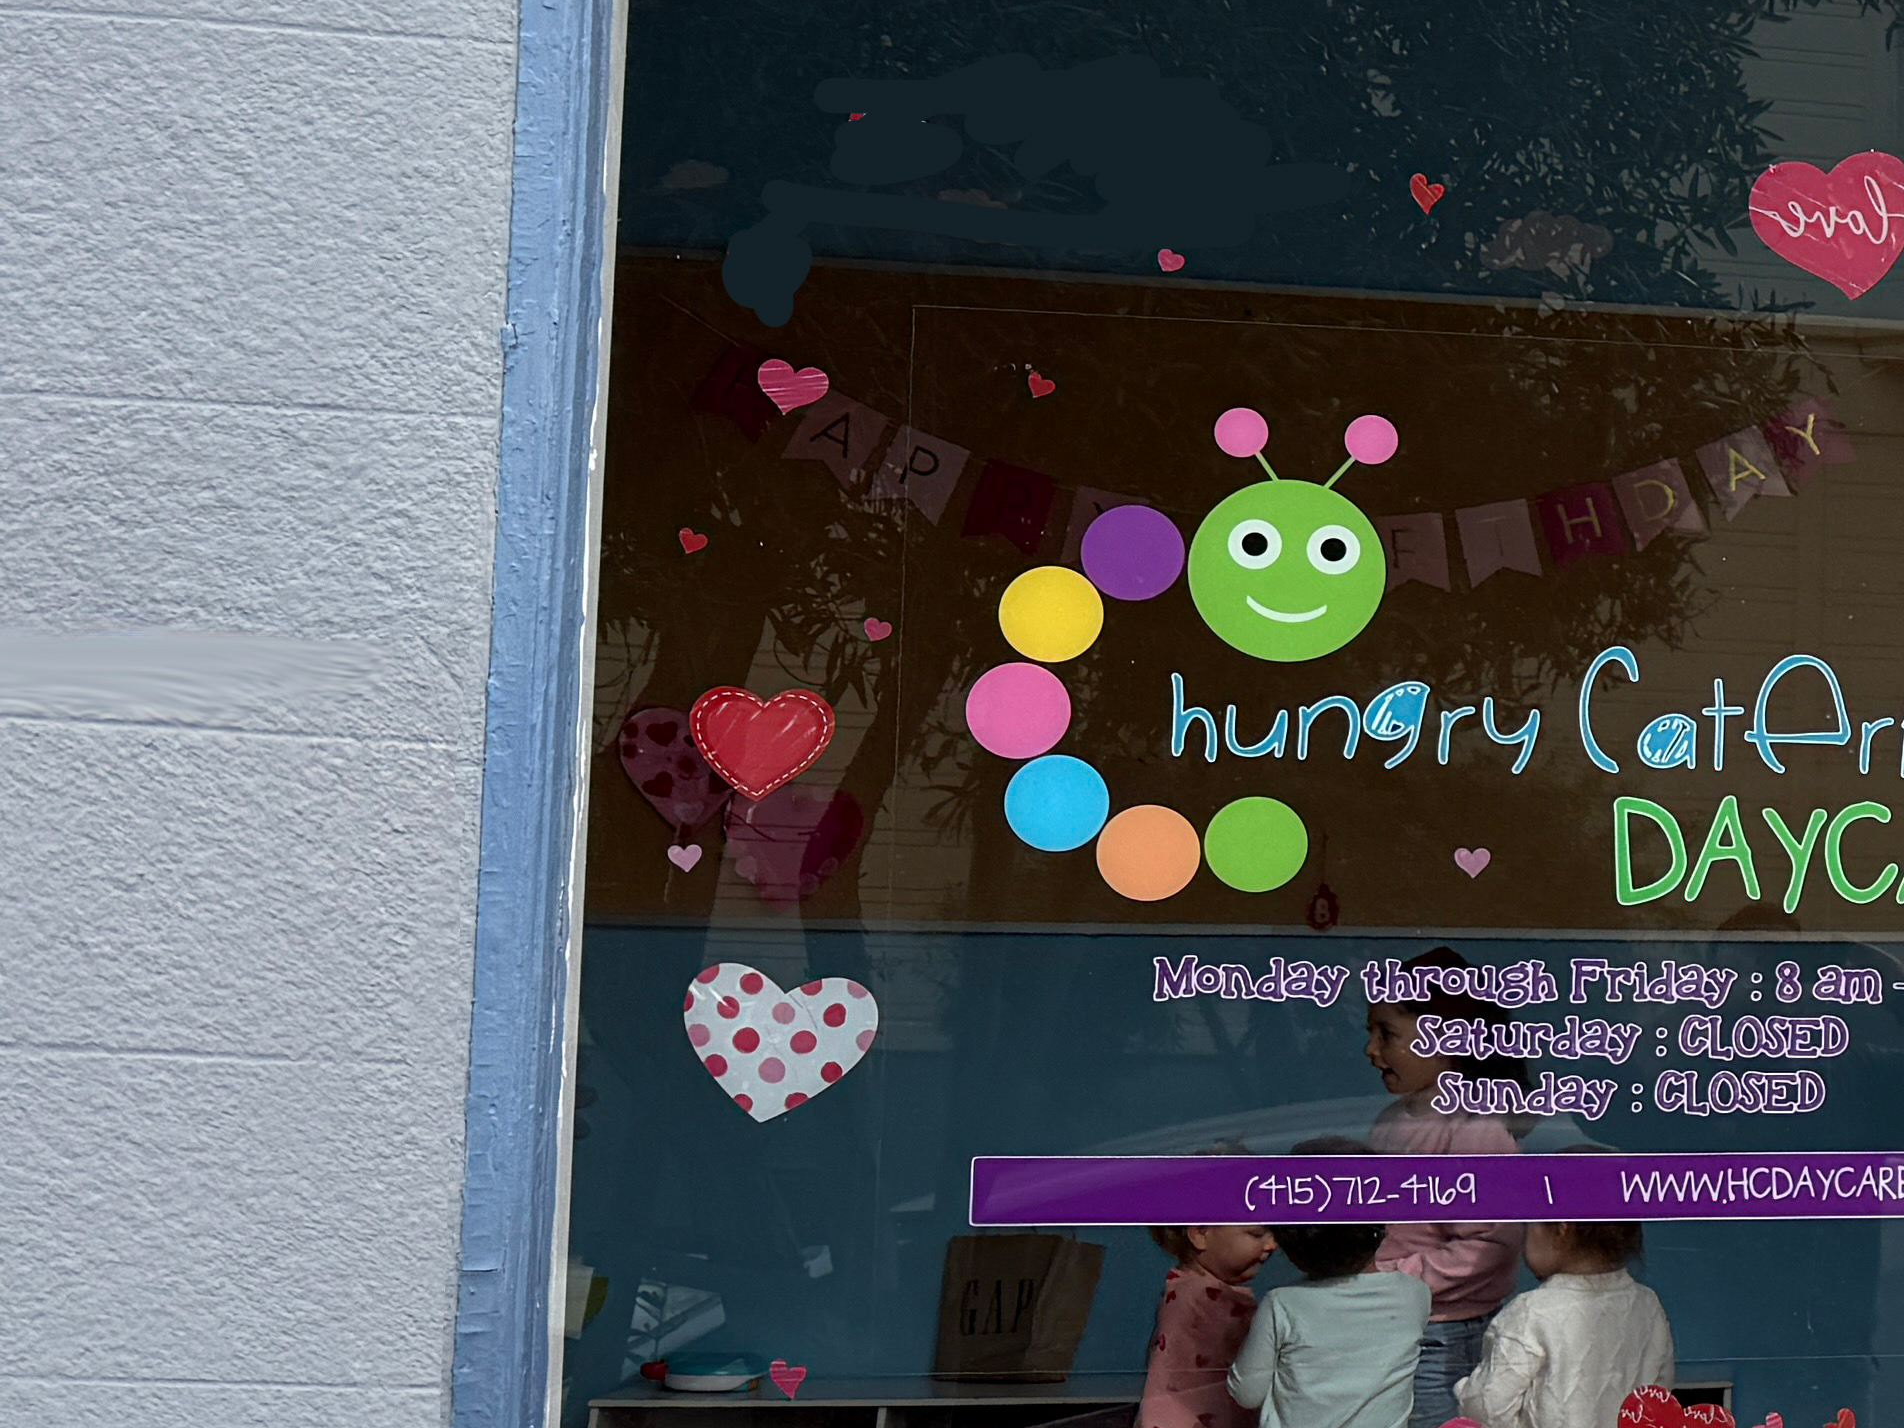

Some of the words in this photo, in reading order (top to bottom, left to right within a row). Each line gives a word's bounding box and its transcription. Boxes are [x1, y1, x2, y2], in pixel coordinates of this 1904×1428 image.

[1170, 672, 1541, 775] hungry
[1153, 955, 1350, 1007] Monday
[1362, 959, 1558, 1008] through
[1570, 958, 1737, 1009] Friday
[1775, 960, 1802, 1003] 8
[1812, 965, 1883, 1005] am
[1409, 1014, 1643, 1065] Saturday
[1678, 1014, 1850, 1061] CLOSED
[1430, 1072, 1618, 1121] Sunday
[1653, 1070, 1826, 1116] CLOSED
[959, 1278, 1034, 1336] GAP
